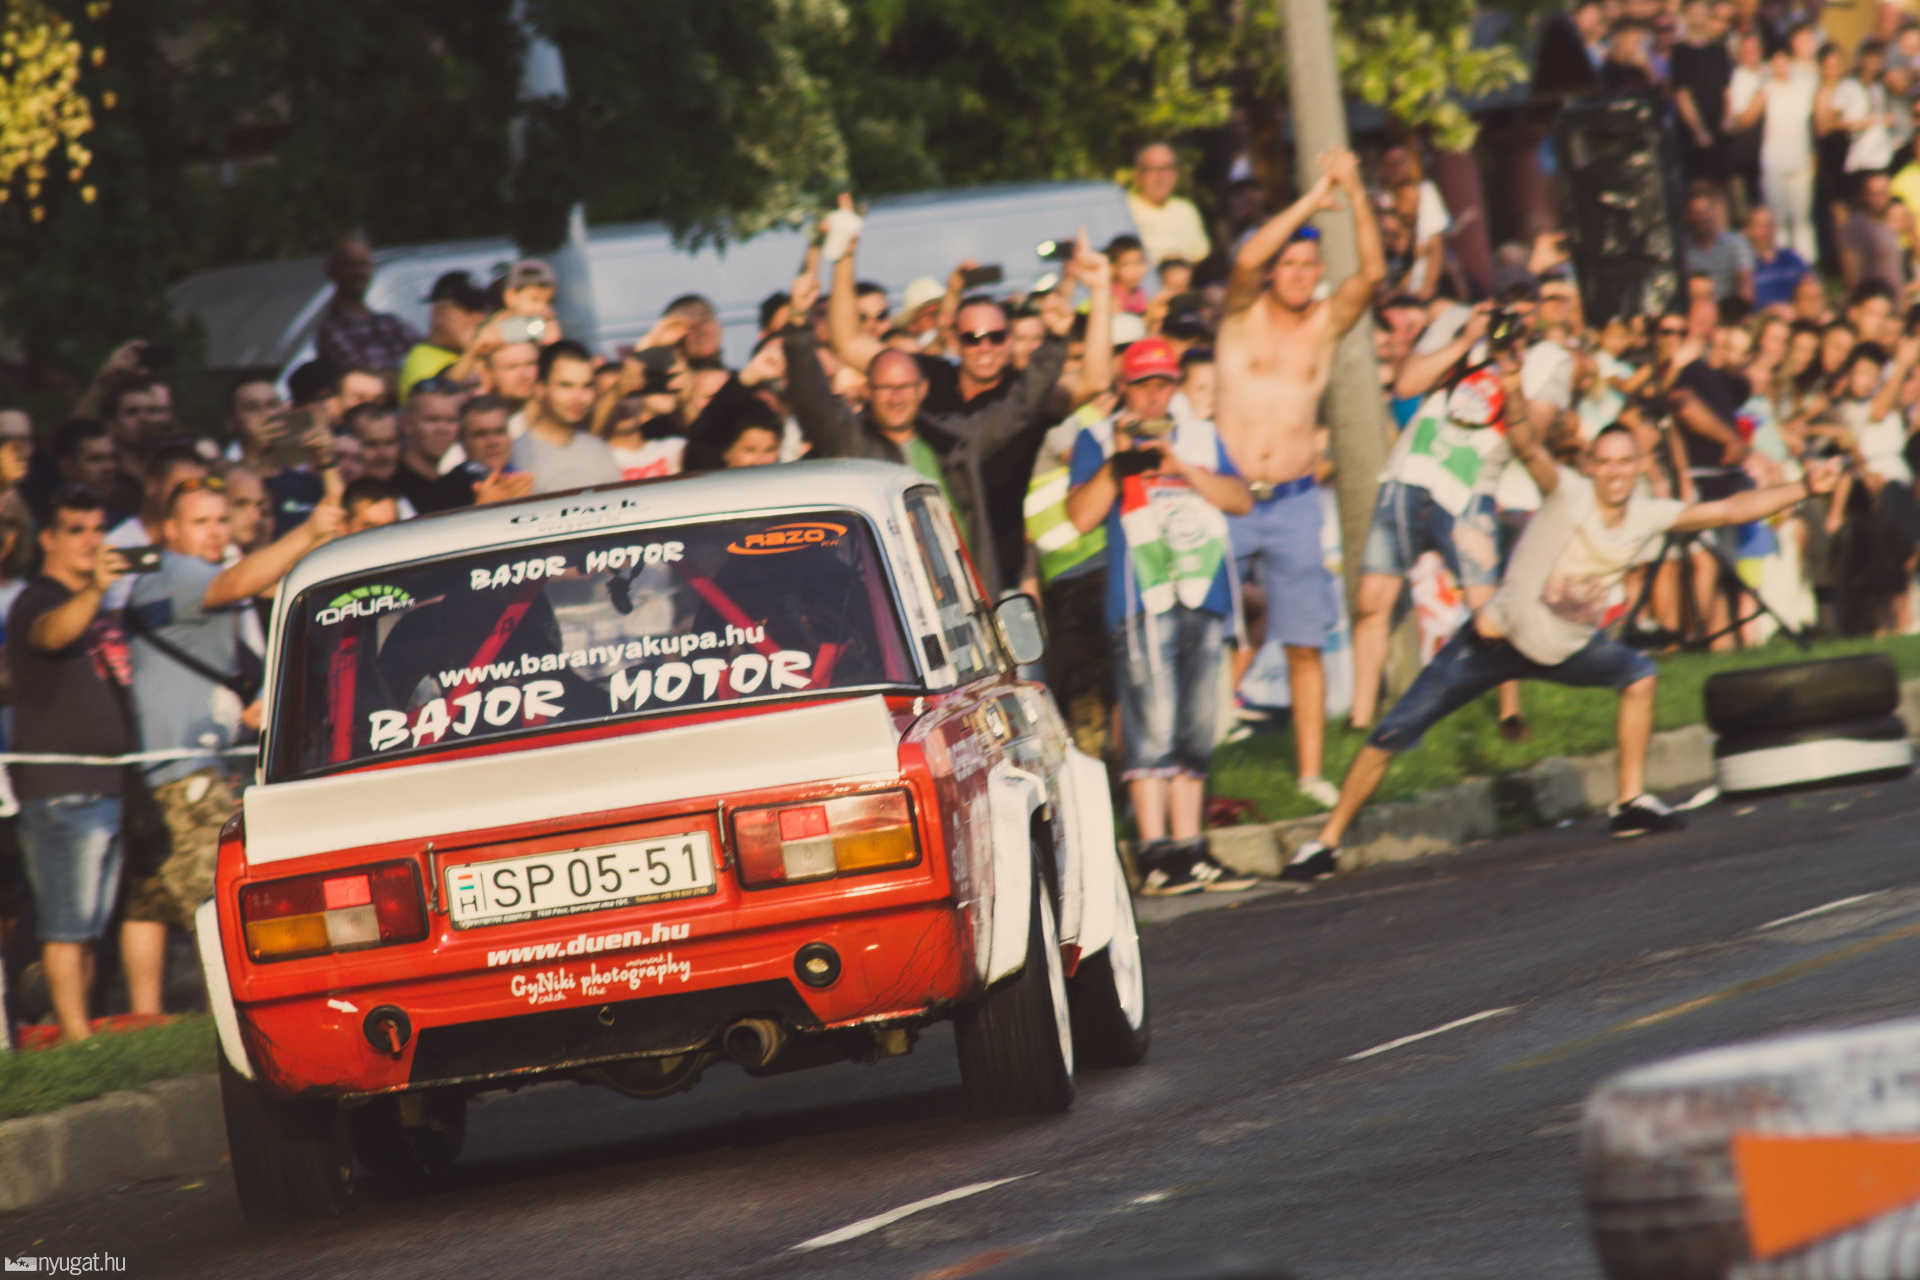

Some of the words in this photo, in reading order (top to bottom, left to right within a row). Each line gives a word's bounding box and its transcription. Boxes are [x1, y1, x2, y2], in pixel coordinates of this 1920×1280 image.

[470, 555, 567, 591] BAJOR
[585, 541, 685, 574] MOTOR
[438, 624, 765, 688] www.baranyakupa.hu
[368, 679, 565, 751] BAJOR
[609, 650, 812, 713] MOTOR
[492, 864, 554, 908] SP
[567, 843, 697, 897] 05-51
[460, 895, 478, 914] H
[487, 922, 691, 968] www.duen.hu
[511, 967, 576, 1005] GyNiki
[580, 952, 691, 996] photography
